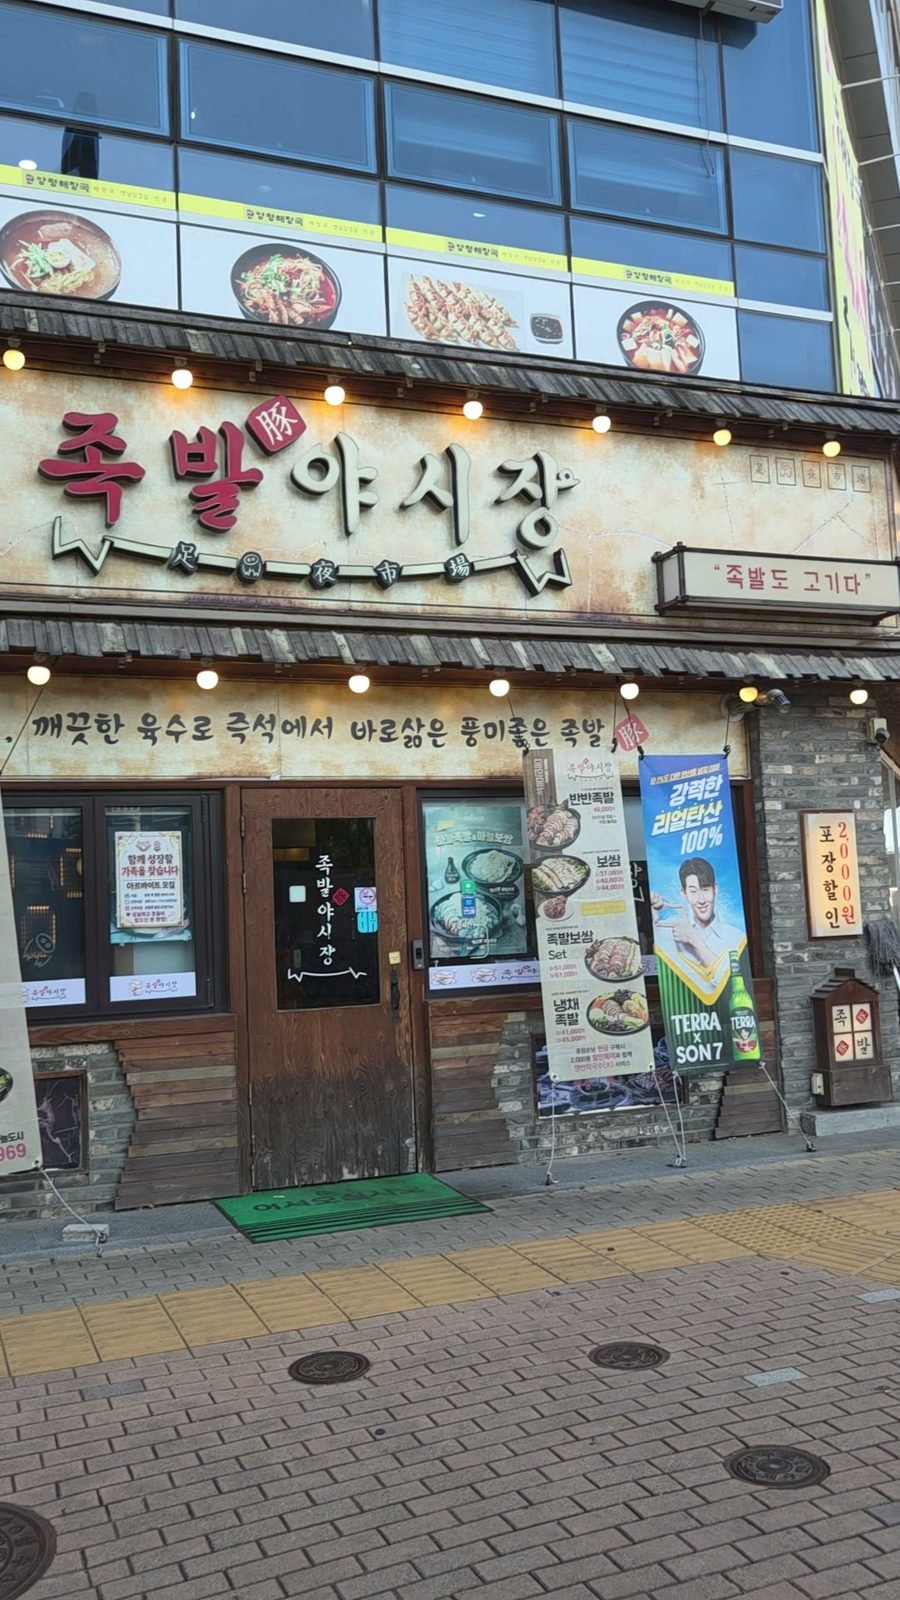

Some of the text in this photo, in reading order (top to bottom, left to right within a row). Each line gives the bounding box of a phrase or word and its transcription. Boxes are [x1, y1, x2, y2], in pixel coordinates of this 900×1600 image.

[255, 402, 302, 445] 豚
[32, 712, 126, 746] 깨끗한
[137, 712, 215, 747] 육수로
[226, 711, 333, 745] 즉석에서
[560, 718, 606, 748] 족발
[569, 791, 614, 807] 반반족발
[669, 774, 724, 808] 강력한
[650, 799, 723, 837] 리얼탄산
[680, 823, 723, 856] 100%
[127, 854, 173, 865] 함께 성장할
[597, 854, 621, 868] 보쌈
[121, 865, 178, 877] 가족을 찾습니다
[819, 825, 841, 929] 포장할인
[126, 881, 176, 890] 아르바이트 모집
[315, 854, 337, 966] 족발야시장
[546, 930, 594, 946] 족발보쌈
[548, 949, 568, 960] Set
[553, 997, 580, 1013] 냉채
[555, 1012, 579, 1027] 족발
[671, 1011, 722, 1035] TERRA
[730, 1015, 757, 1031] TERRA
[570, 1055, 591, 1063] 2,000원
